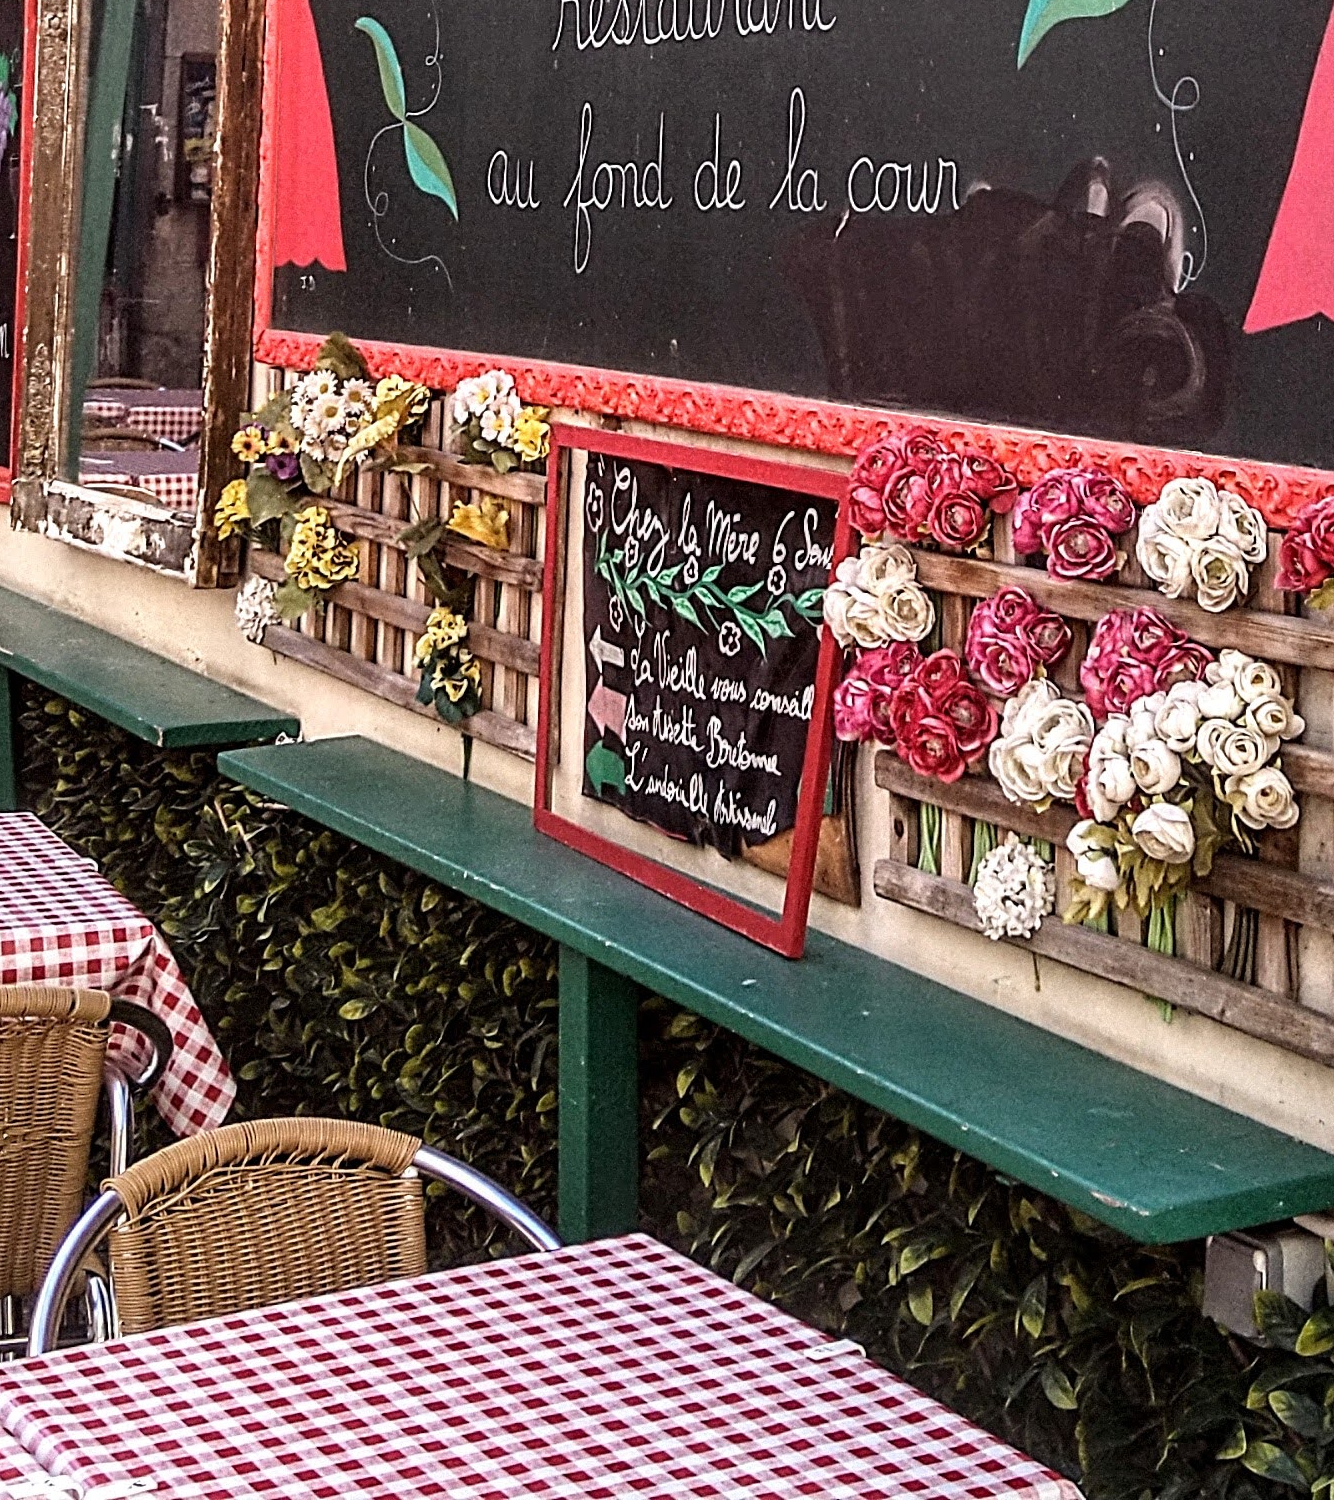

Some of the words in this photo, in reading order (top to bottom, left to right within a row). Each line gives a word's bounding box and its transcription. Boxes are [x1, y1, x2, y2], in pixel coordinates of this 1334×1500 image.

[486, 150, 540, 209] au
[564, 104, 672, 273] fond
[694, 113, 745, 210] de
[771, 88, 829, 212] la
[848, 153, 960, 214] cour
[678, 492, 701, 556] la
[773, 510, 795, 563] 6
[631, 615, 654, 686] La
[654, 629, 706, 700] Vieille
[710, 677, 747, 703] vous
